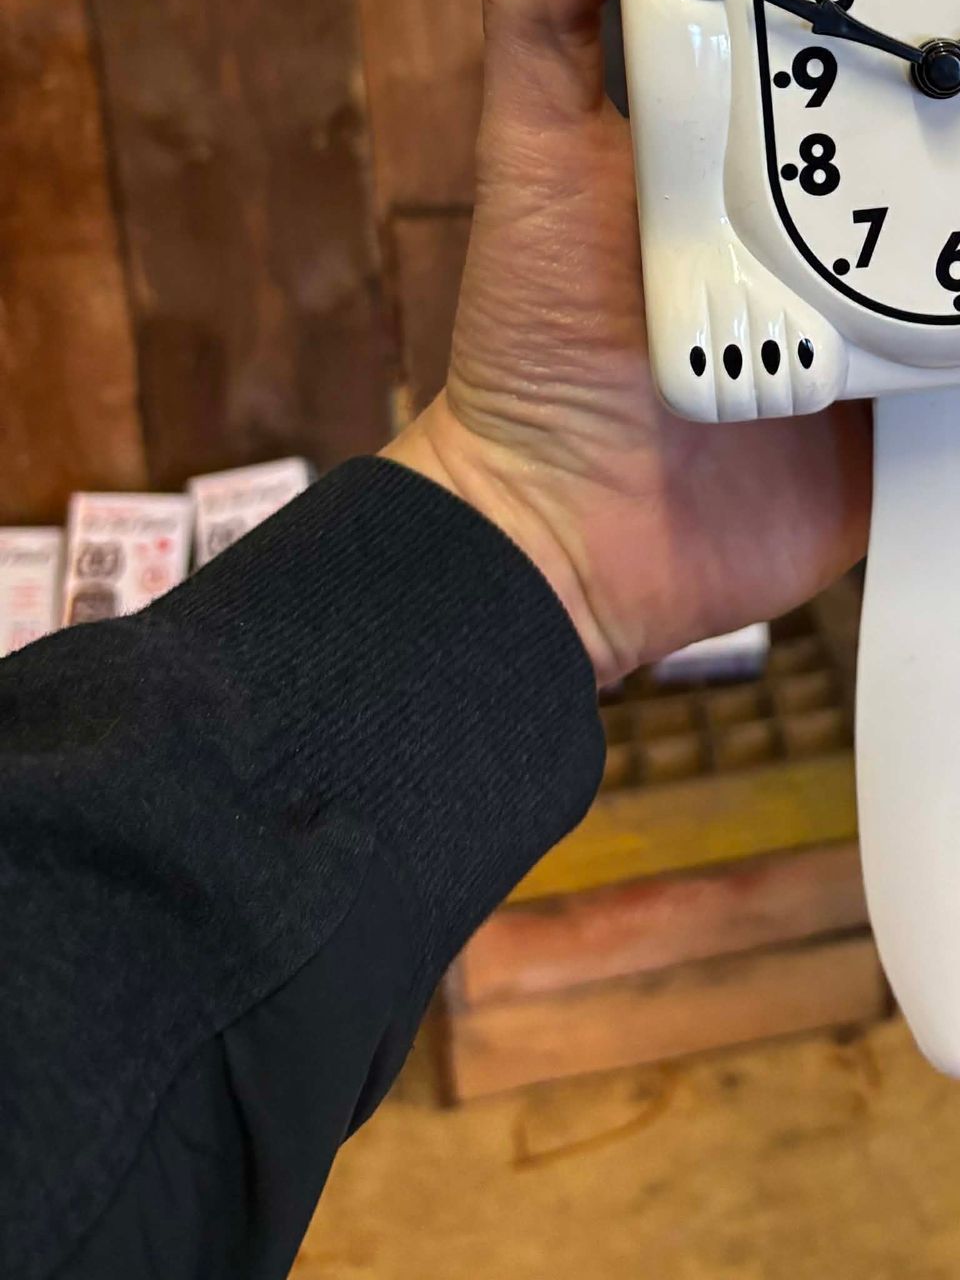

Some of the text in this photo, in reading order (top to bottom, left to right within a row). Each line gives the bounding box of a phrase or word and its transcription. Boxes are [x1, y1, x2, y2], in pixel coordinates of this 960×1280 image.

[791, 45, 839, 109] 9
[798, 132, 841, 197] 8
[852, 206, 889, 269] 7
